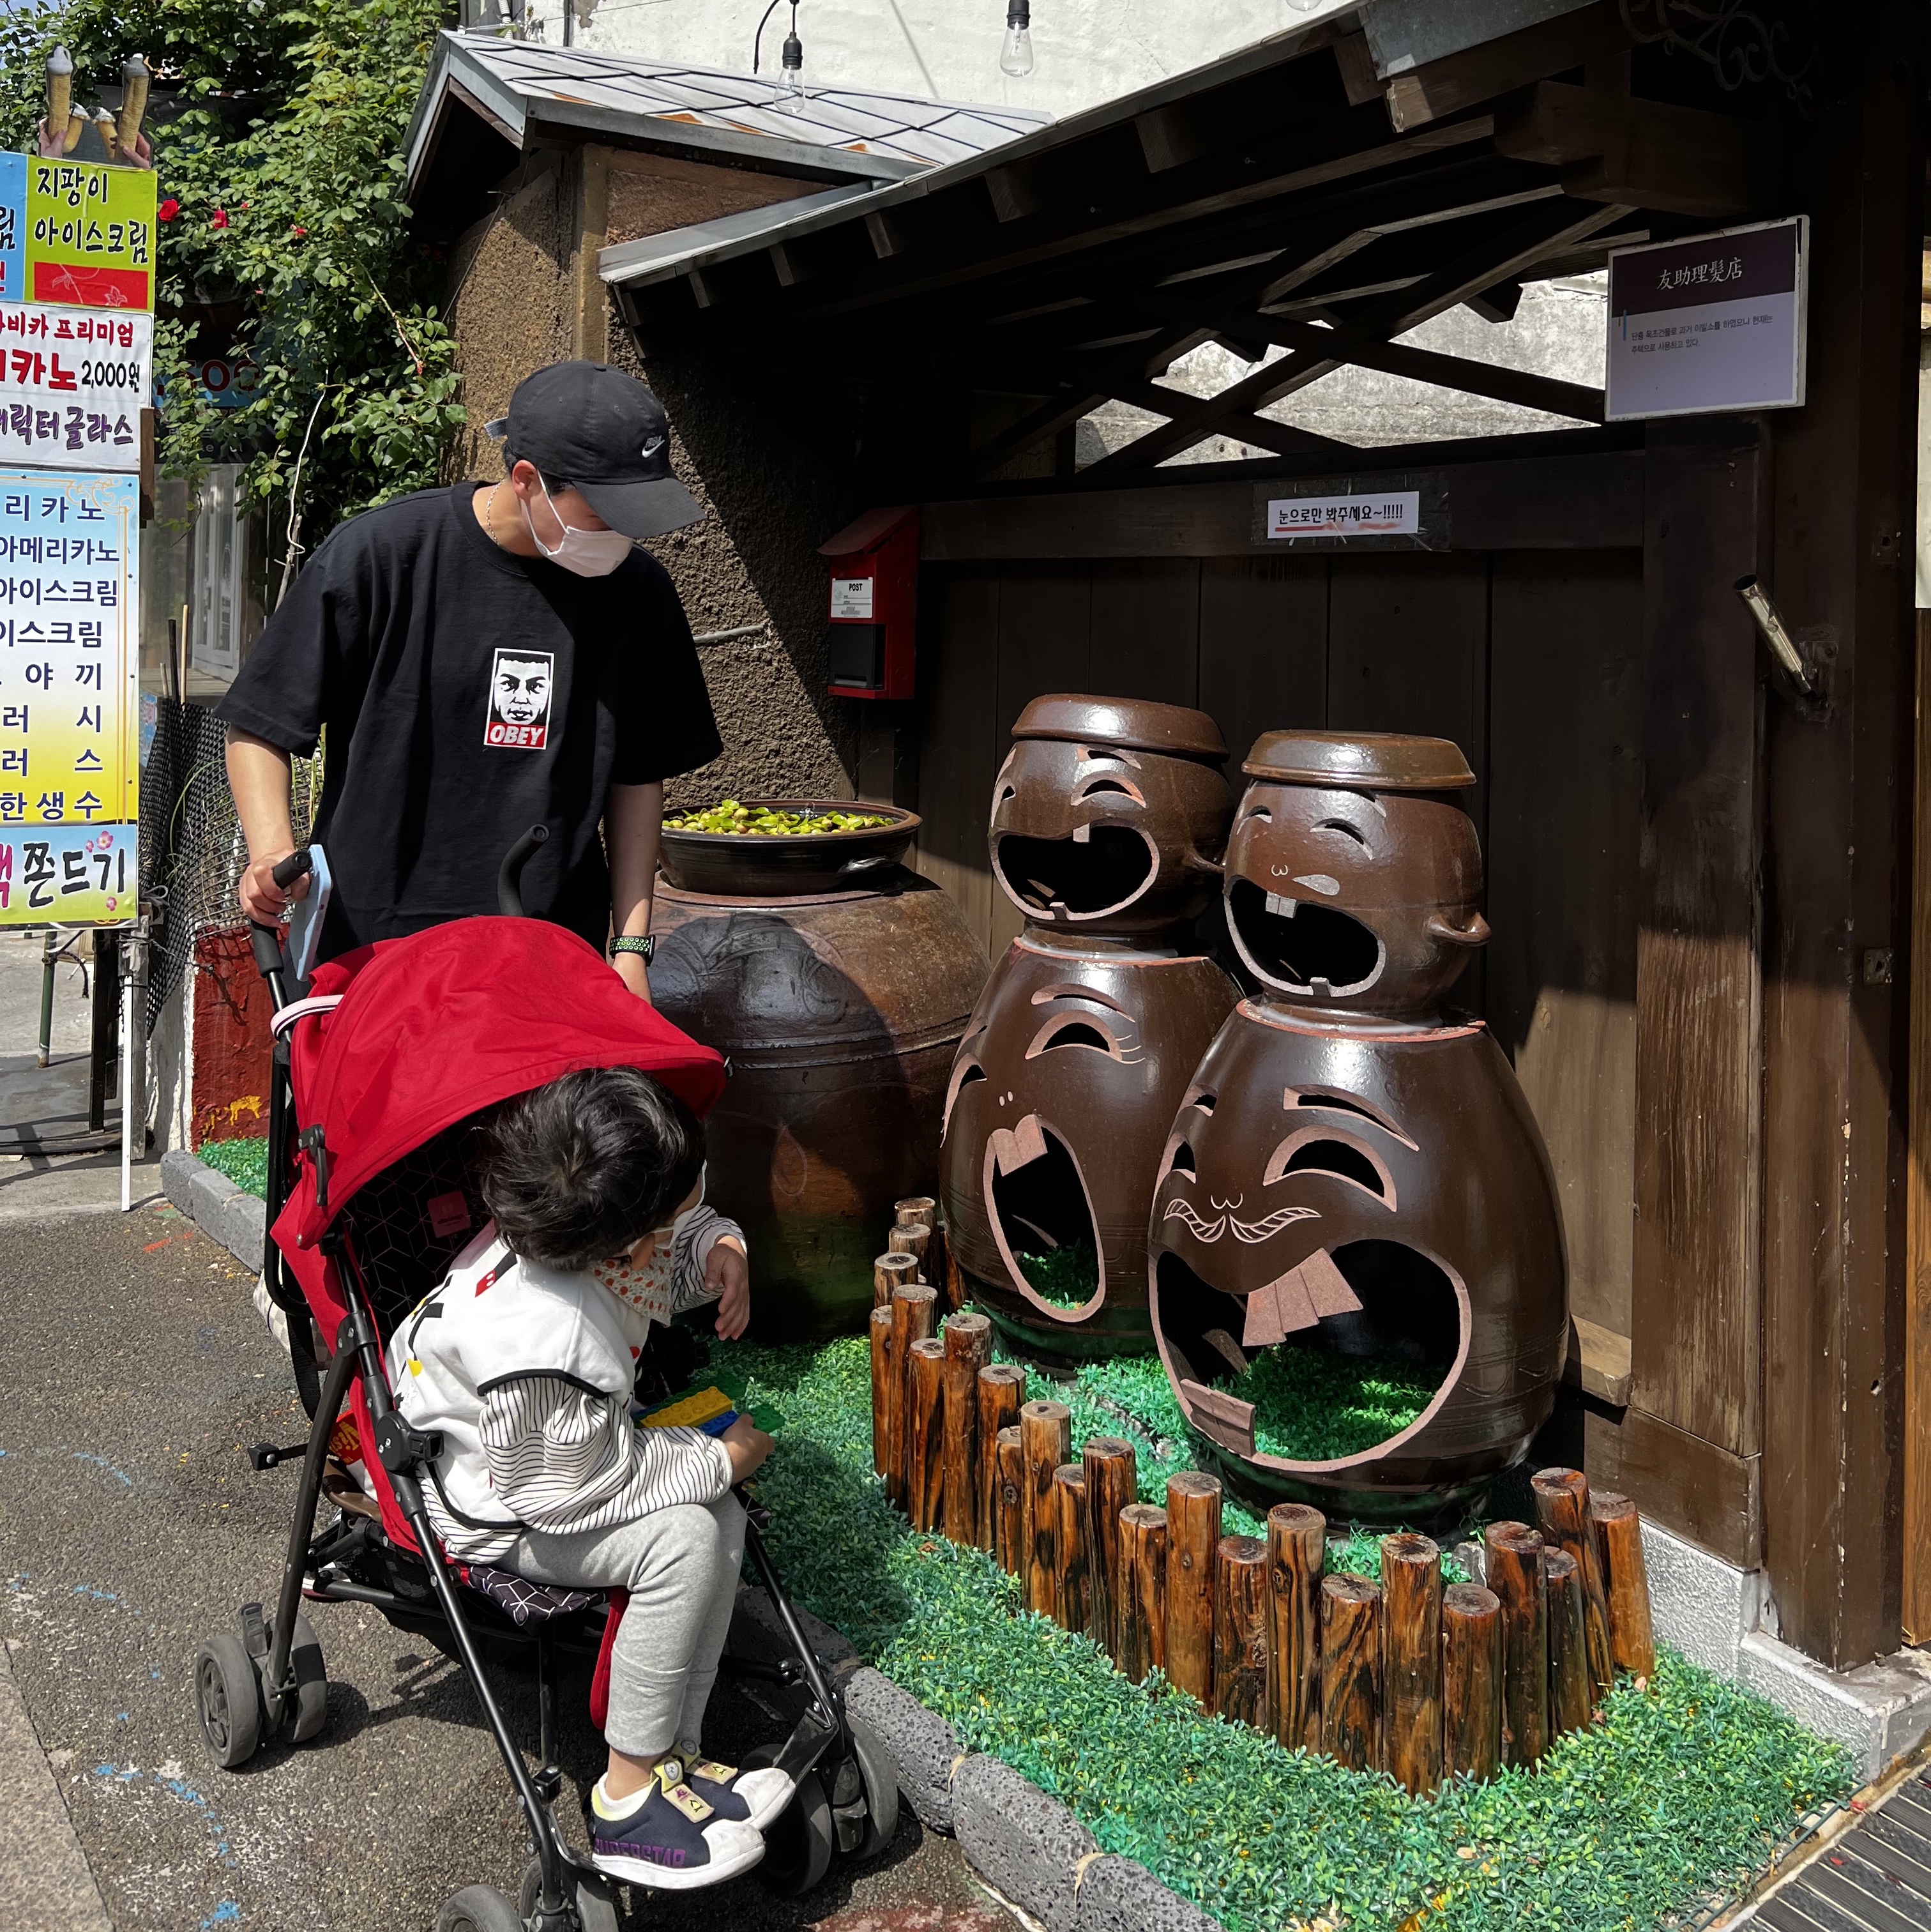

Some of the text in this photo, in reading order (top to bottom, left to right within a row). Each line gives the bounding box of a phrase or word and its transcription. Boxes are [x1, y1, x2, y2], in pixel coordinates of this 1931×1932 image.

[37, 167, 107, 206] 지팡이
[34, 217, 148, 263] 아이스크림
[1656, 257, 1743, 290] 友助理髮店
[54, 318, 133, 347] 프리미엄
[81, 360, 140, 393] 2,000원
[1279, 507, 1322, 524] 눈으로만
[0, 535, 120, 565] 아메리카노
[0, 577, 117, 607] 아이스크림
[849, 583, 863, 591] POST
[490, 724, 544, 746] OBEY
[0, 791, 103, 821] 한생수
